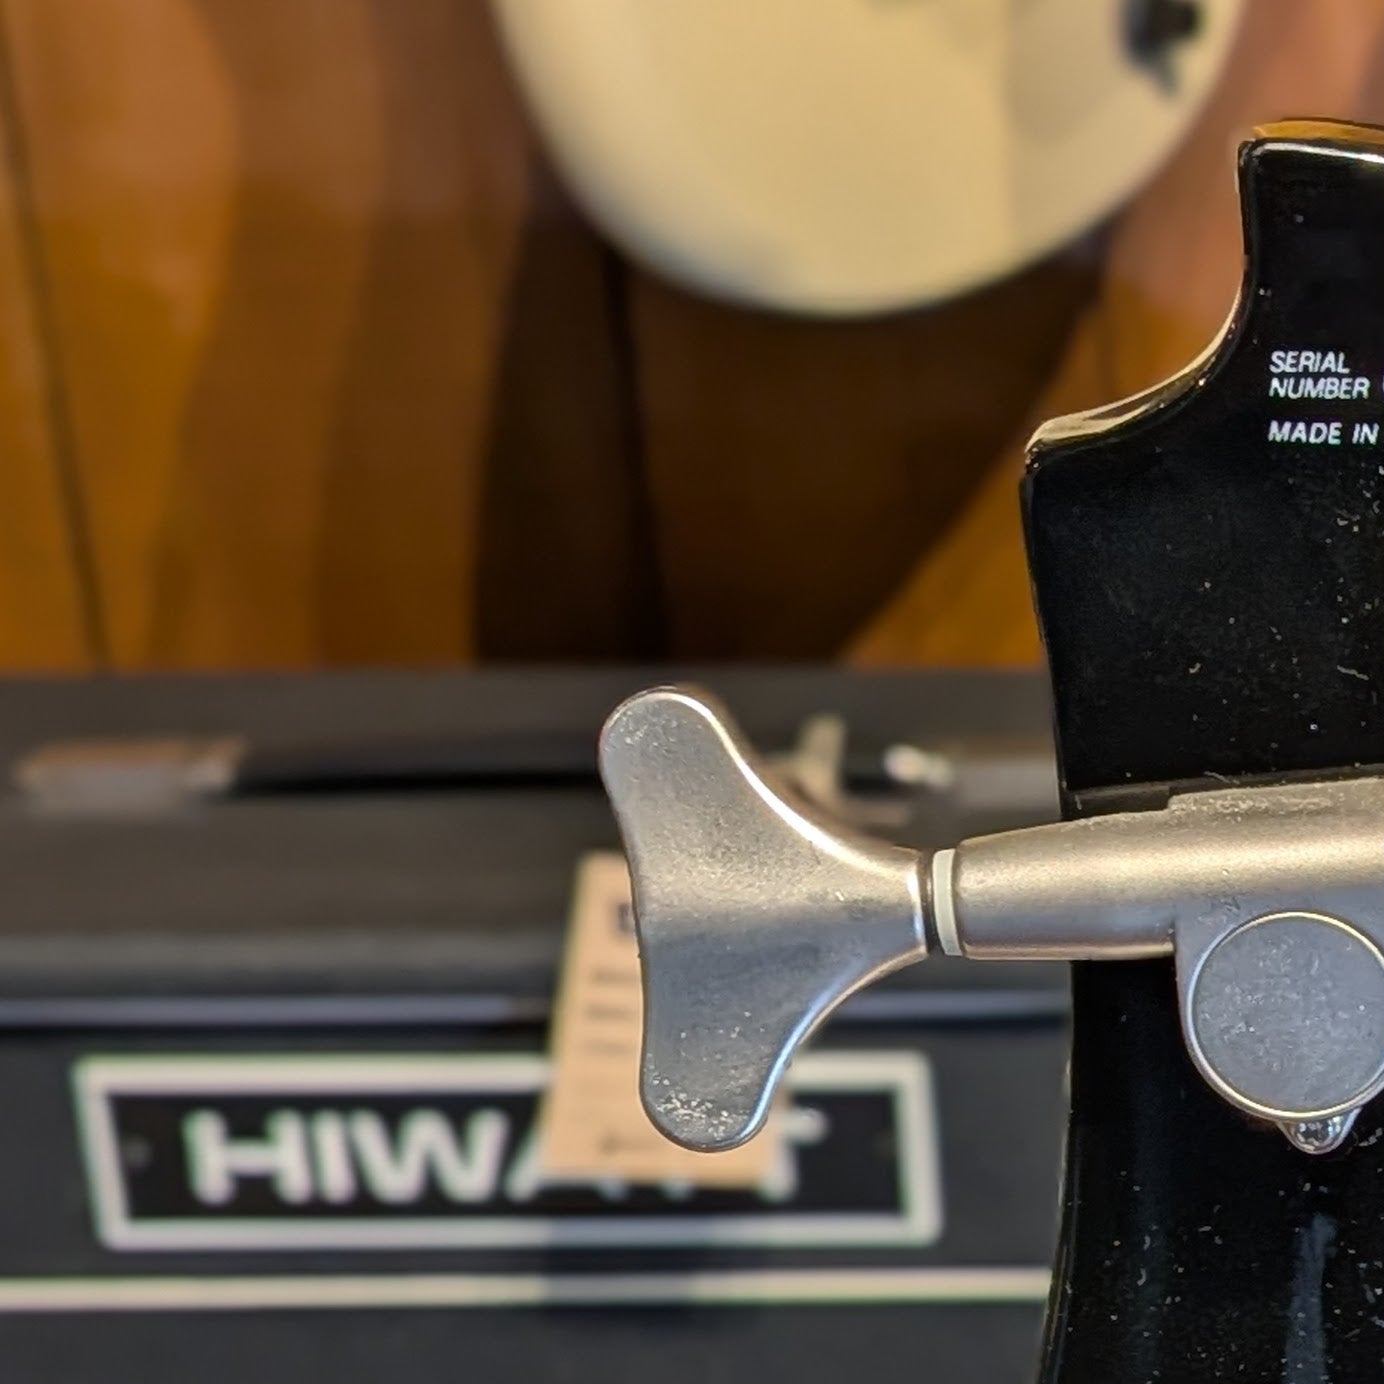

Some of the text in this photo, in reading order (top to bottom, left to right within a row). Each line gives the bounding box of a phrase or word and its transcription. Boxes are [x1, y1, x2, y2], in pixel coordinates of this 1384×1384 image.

[1268, 350, 1350, 374] SERIAL
[1268, 376, 1371, 400] NUMBER
[1267, 420, 1343, 446] MADE
[1351, 422, 1380, 446] IN
